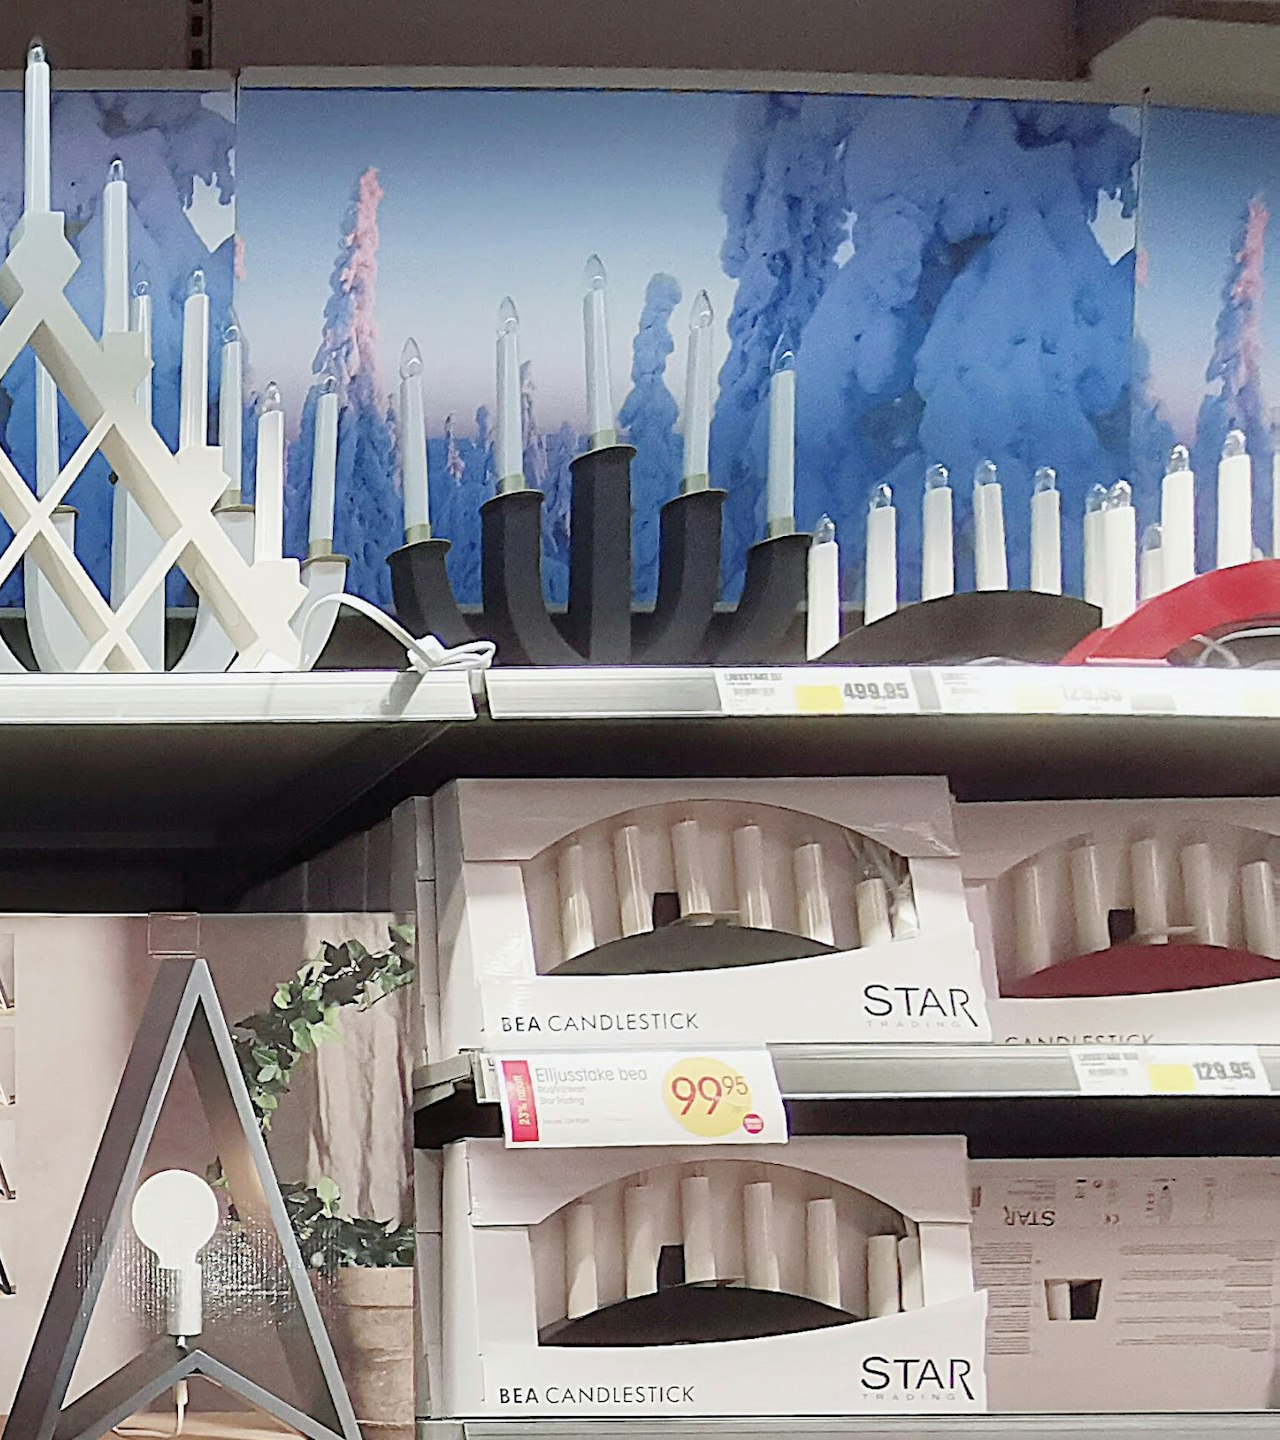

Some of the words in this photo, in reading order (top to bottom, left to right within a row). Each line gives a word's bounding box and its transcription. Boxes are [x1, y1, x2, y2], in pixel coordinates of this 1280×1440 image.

[862, 983, 981, 1027] STAR
[501, 1017, 541, 1033] BEA
[548, 1012, 699, 1033] CANDLESTICK
[865, 1020, 961, 1029] TRADING
[535, 1067, 615, 1084] Elljusstake
[621, 1067, 648, 1080] bea
[672, 1076, 722, 1115] 99
[721, 1075, 748, 1095] 95
[1004, 1205, 1056, 1226] STAR
[860, 1356, 974, 1401] STAR
[500, 1389, 539, 1405] BEA
[546, 1385, 695, 1405] CANDLESTICK
